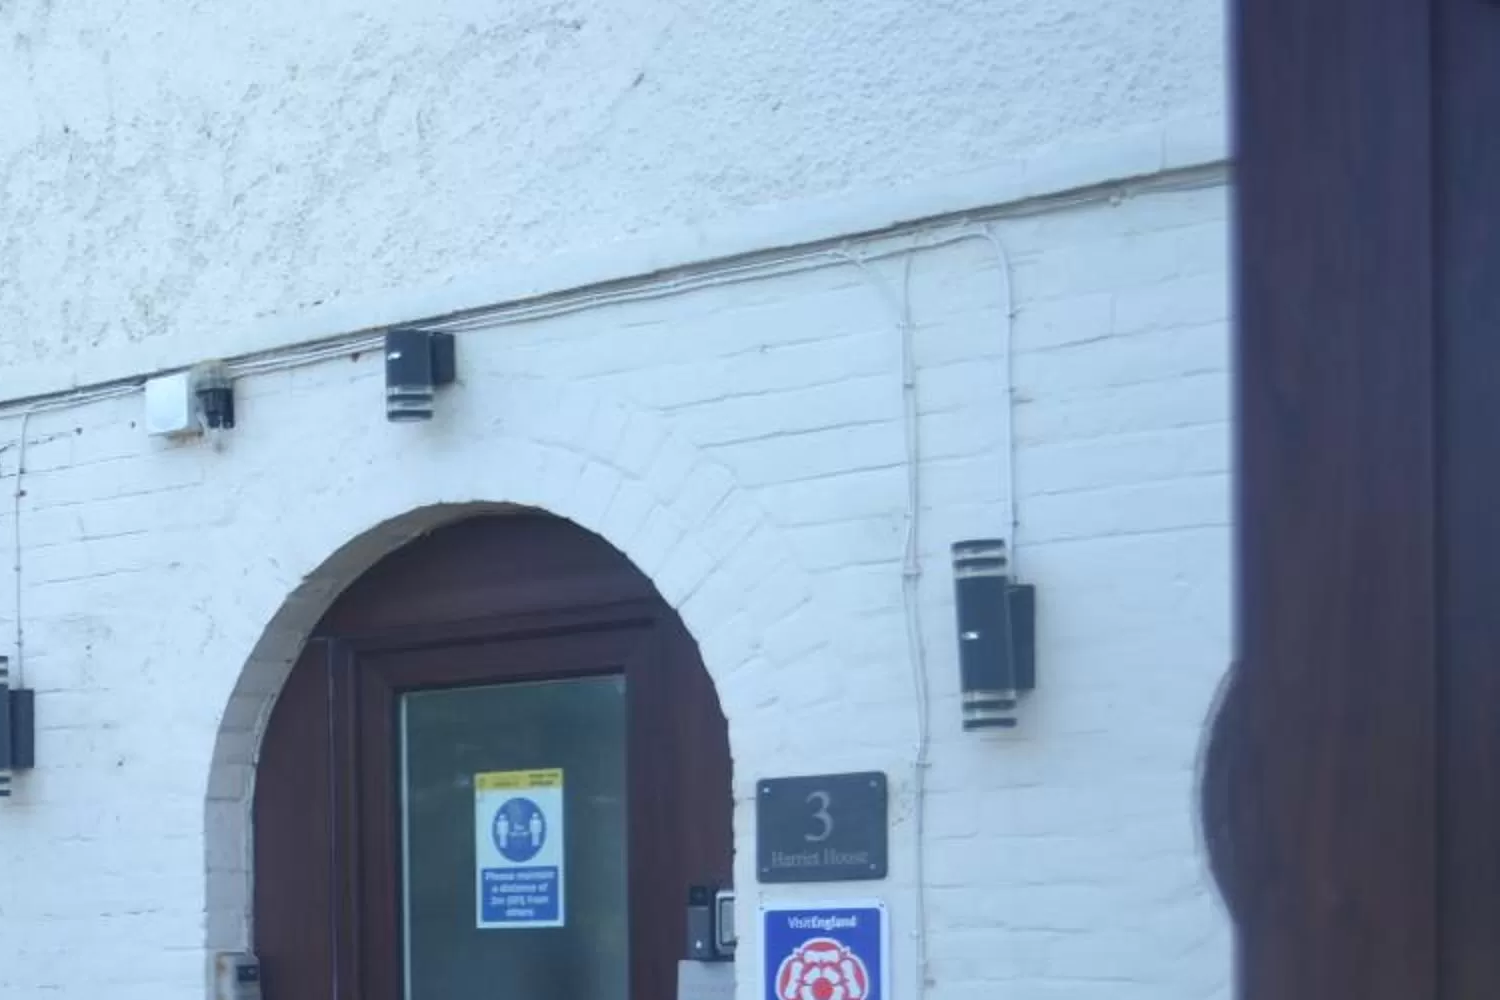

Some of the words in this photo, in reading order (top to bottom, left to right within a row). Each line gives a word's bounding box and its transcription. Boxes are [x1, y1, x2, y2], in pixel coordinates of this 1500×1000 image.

[803, 790, 834, 841] 3
[823, 847, 869, 866] House
[787, 914, 857, 931] VisitEngland
